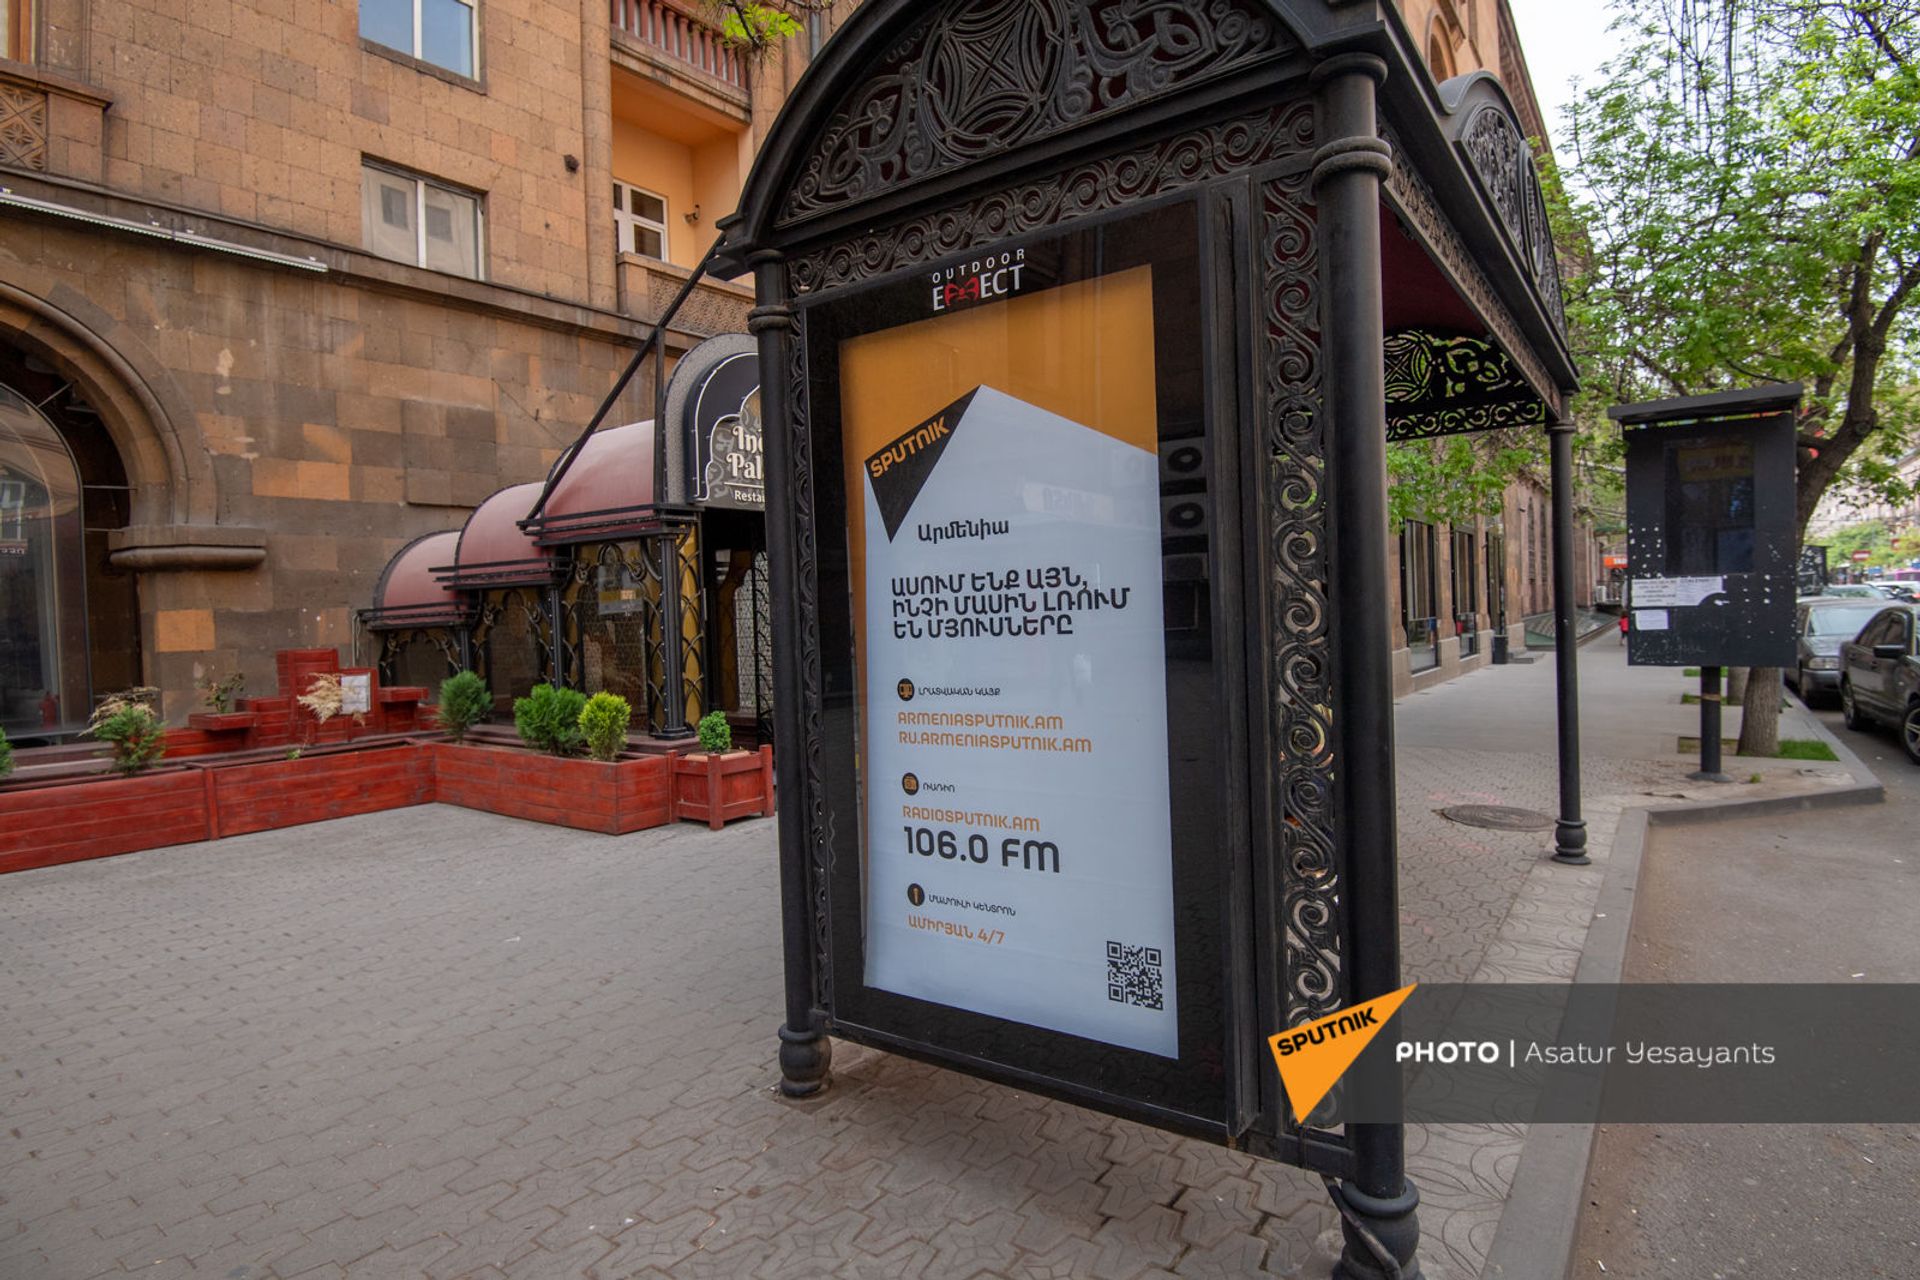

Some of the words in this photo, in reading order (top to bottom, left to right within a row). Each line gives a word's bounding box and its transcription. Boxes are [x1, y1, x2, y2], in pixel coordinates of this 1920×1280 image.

[932, 248, 1025, 284] OUTDOOR
[870, 416, 950, 478] SPUTNIK
[917, 519, 1009, 544] Արմենիա
[891, 574, 965, 597] ԱՍՈՒՄ
[971, 570, 1019, 592] ԵՆՔ
[892, 597, 949, 617] ԻՆՉԻ
[954, 591, 1036, 615] ՄԱՍԻՆ
[1043, 587, 1130, 612] ԼՌՈՒՄ
[893, 620, 922, 639] ԵՆ
[898, 712, 1063, 730] ARMENIASPUTNIK.AM
[899, 731, 1092, 753] RU.ARMENIASPUTNIK.AM
[903, 805, 1040, 832] RADIOSPUTNIK.AM
[904, 826, 989, 864] 106.0
[1001, 838, 1060, 873] FM
[908, 914, 974, 939] ԱՄԻՐՅԱՆ
[977, 928, 1005, 944] 4/7
